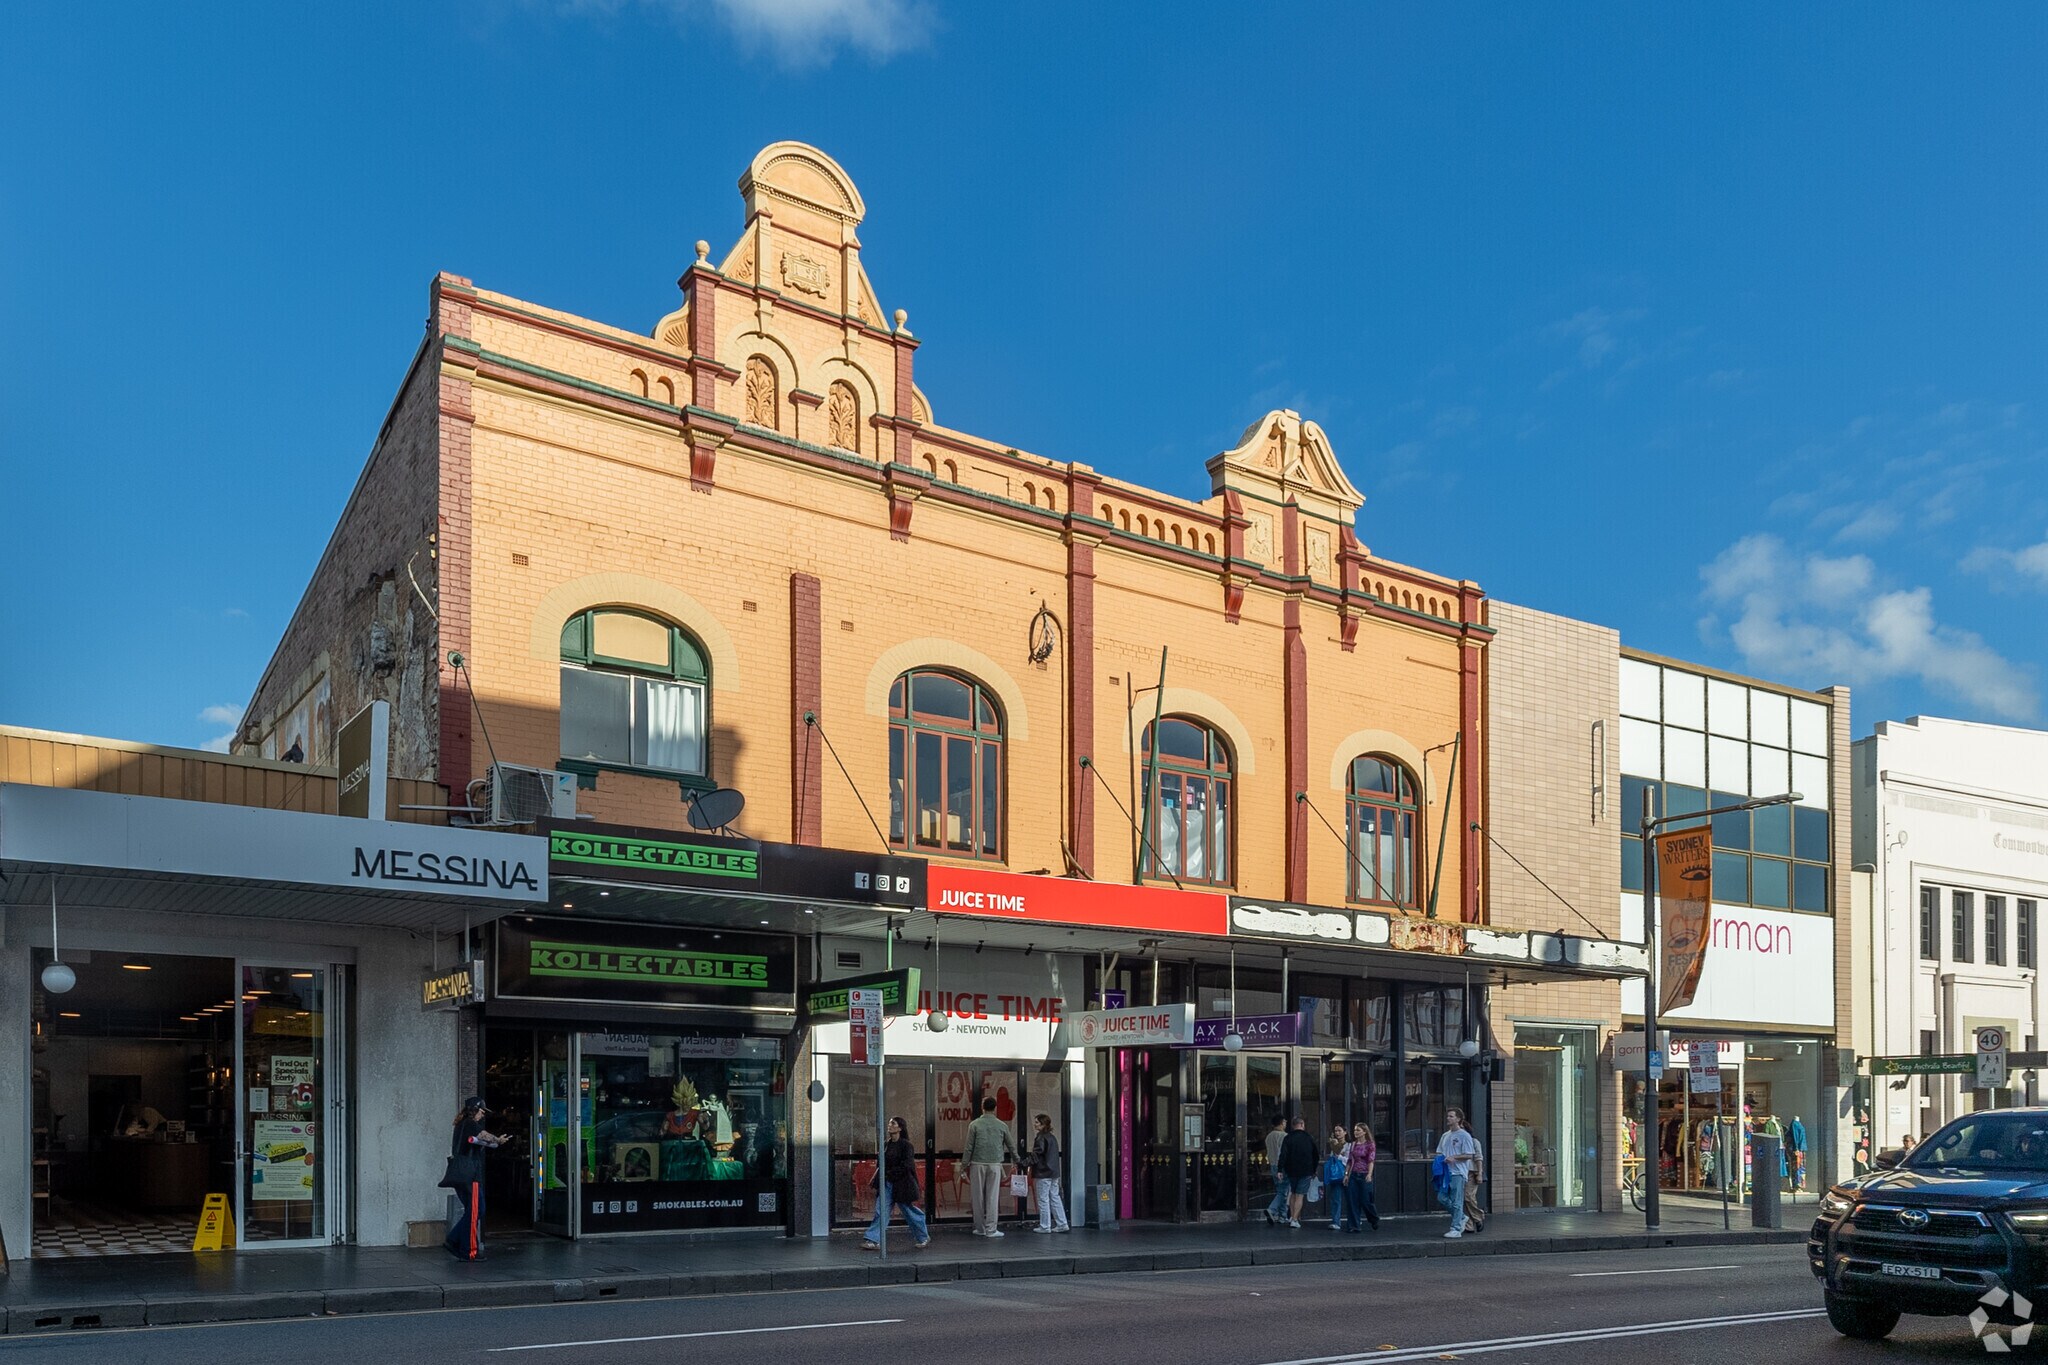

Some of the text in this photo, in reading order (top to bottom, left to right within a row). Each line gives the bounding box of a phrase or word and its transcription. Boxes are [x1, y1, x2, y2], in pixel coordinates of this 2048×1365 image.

[1666, 834, 1704, 852] SYDNEY
[551, 838, 758, 873] KOLLECTABLES
[1663, 847, 1709, 865] WRITERS
[351, 847, 538, 891] MESSINA
[939, 889, 1026, 913] JUICE TIME
[1712, 917, 1792, 956] rman
[530, 949, 768, 980] KOLLECTABLES
[1668, 951, 1698, 966] FEST
[424, 971, 473, 1004] MESSINA
[852, 992, 860, 1001] C
[810, 985, 900, 1010] KOLLEES
[916, 990, 988, 1020] JUICE
[997, 995, 1063, 1023] TIME
[912, 1022, 949, 1033] SYDY
[956, 1024, 1007, 1036] NEWTOWN
[1103, 1014, 1170, 1033] JUICE TIME
[1195, 1024, 1216, 1036] AX
[1670, 1038, 1731, 1056] gon
[1980, 1034, 1999, 1045] 40
[1618, 1044, 1659, 1057] gorm
[275, 1067, 309, 1075] Specials
[1897, 1063, 1912, 1072] Keep
[1913, 1062, 1940, 1071] Australia
[1943, 1060, 1970, 1070] Beautiful
[275, 1074, 296, 1083] Early
[937, 1071, 993, 1104] LOVE
[652, 1199, 744, 1210] SMOKABLES.COM.AU
